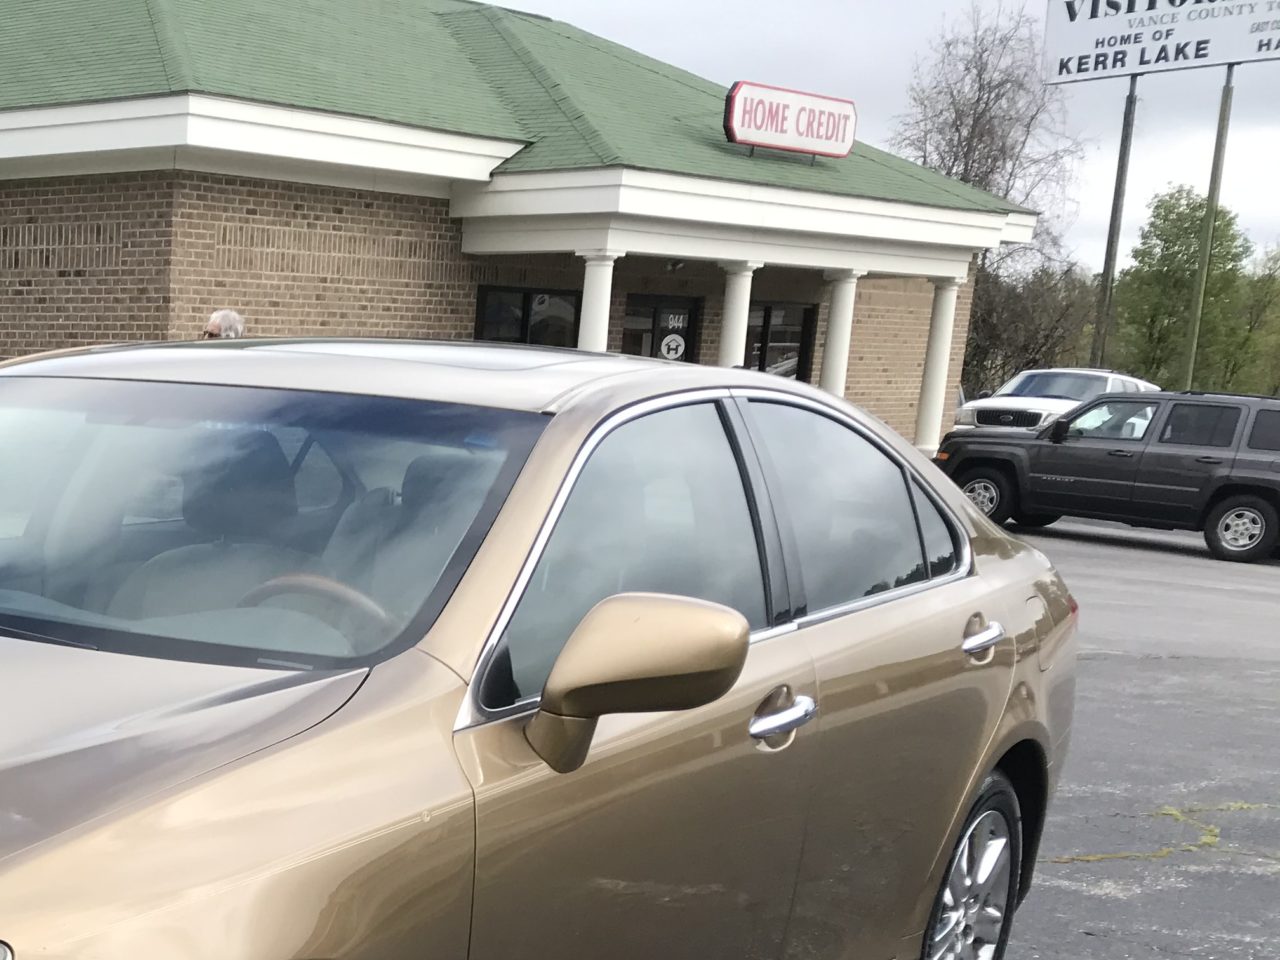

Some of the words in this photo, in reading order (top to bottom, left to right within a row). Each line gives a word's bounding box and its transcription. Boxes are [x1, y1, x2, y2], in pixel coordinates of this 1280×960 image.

[1127, 12, 1181, 29] VANCE
[1186, 2, 1257, 21] COUNTY
[1095, 32, 1144, 49] HOME
[1151, 28, 1176, 42] OF
[1058, 49, 1128, 76] KERR
[1138, 39, 1212, 66] LAKE
[741, 96, 790, 134] HOME
[795, 106, 851, 144] CREDIT
[668, 314, 683, 329] 944
